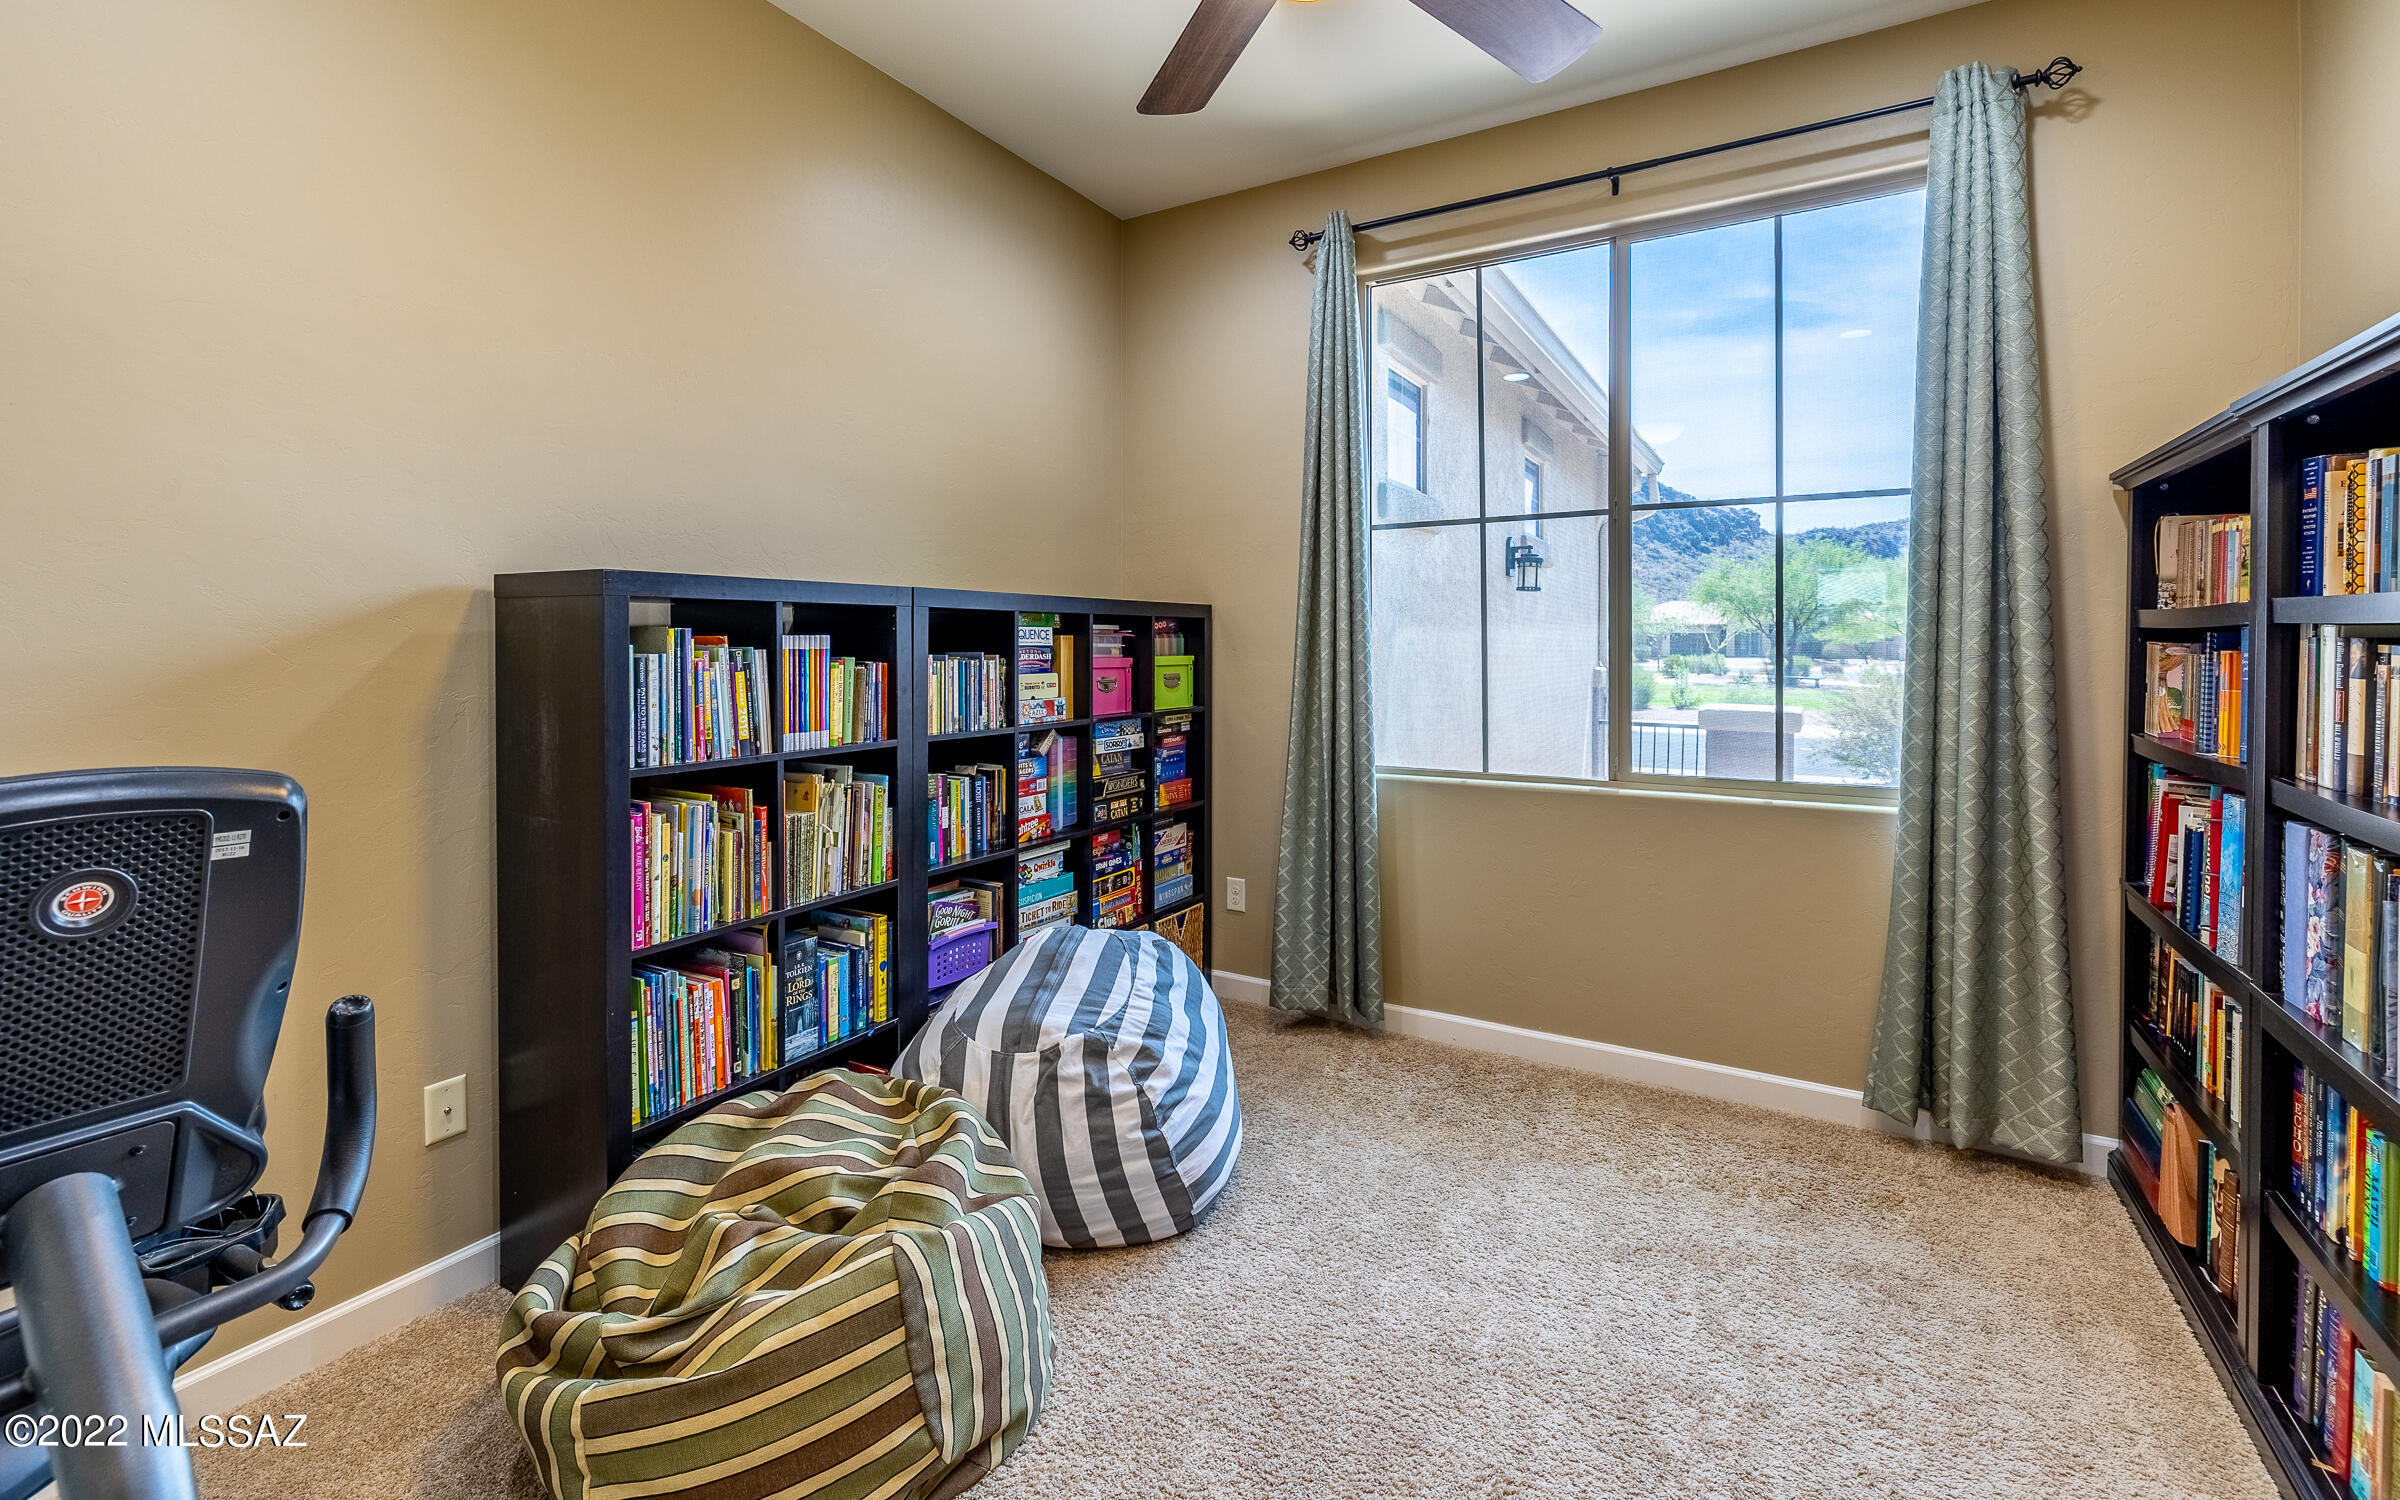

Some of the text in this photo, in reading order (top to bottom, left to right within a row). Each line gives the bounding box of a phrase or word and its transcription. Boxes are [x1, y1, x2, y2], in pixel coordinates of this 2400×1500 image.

[2336, 641, 2344, 662] Killing
[2336, 663, 2344, 689] England
[737, 674, 745, 707] ALMANAC
[640, 706, 647, 716] TO
[739, 708, 748, 737] 2019
[2334, 723, 2342, 736] BILL
[1100, 752, 1123, 764] CATAN
[1107, 775, 1139, 791] WONDERS
[1110, 807, 1129, 820] CATAN
[1159, 836, 1179, 847] AMERICAN
[1033, 858, 1056, 873] Qwirkle
[60, 885, 108, 902] SCHWINN
[1158, 883, 1188, 902] WINGSPAN
[61, 904, 103, 918] QUALITY
[935, 904, 976, 920] GOOD NIGHT
[1020, 906, 1047, 923] TICKET
[1051, 900, 1067, 913] RIDE
[1097, 916, 1117, 929] Clue
[785, 964, 813, 979] TOLKIEN
[787, 979, 811, 994] LORD
[786, 986, 814, 1004] RINGS
[2293, 1101, 2302, 1152] ECHO
[2370, 1173, 2379, 1229] MATH
